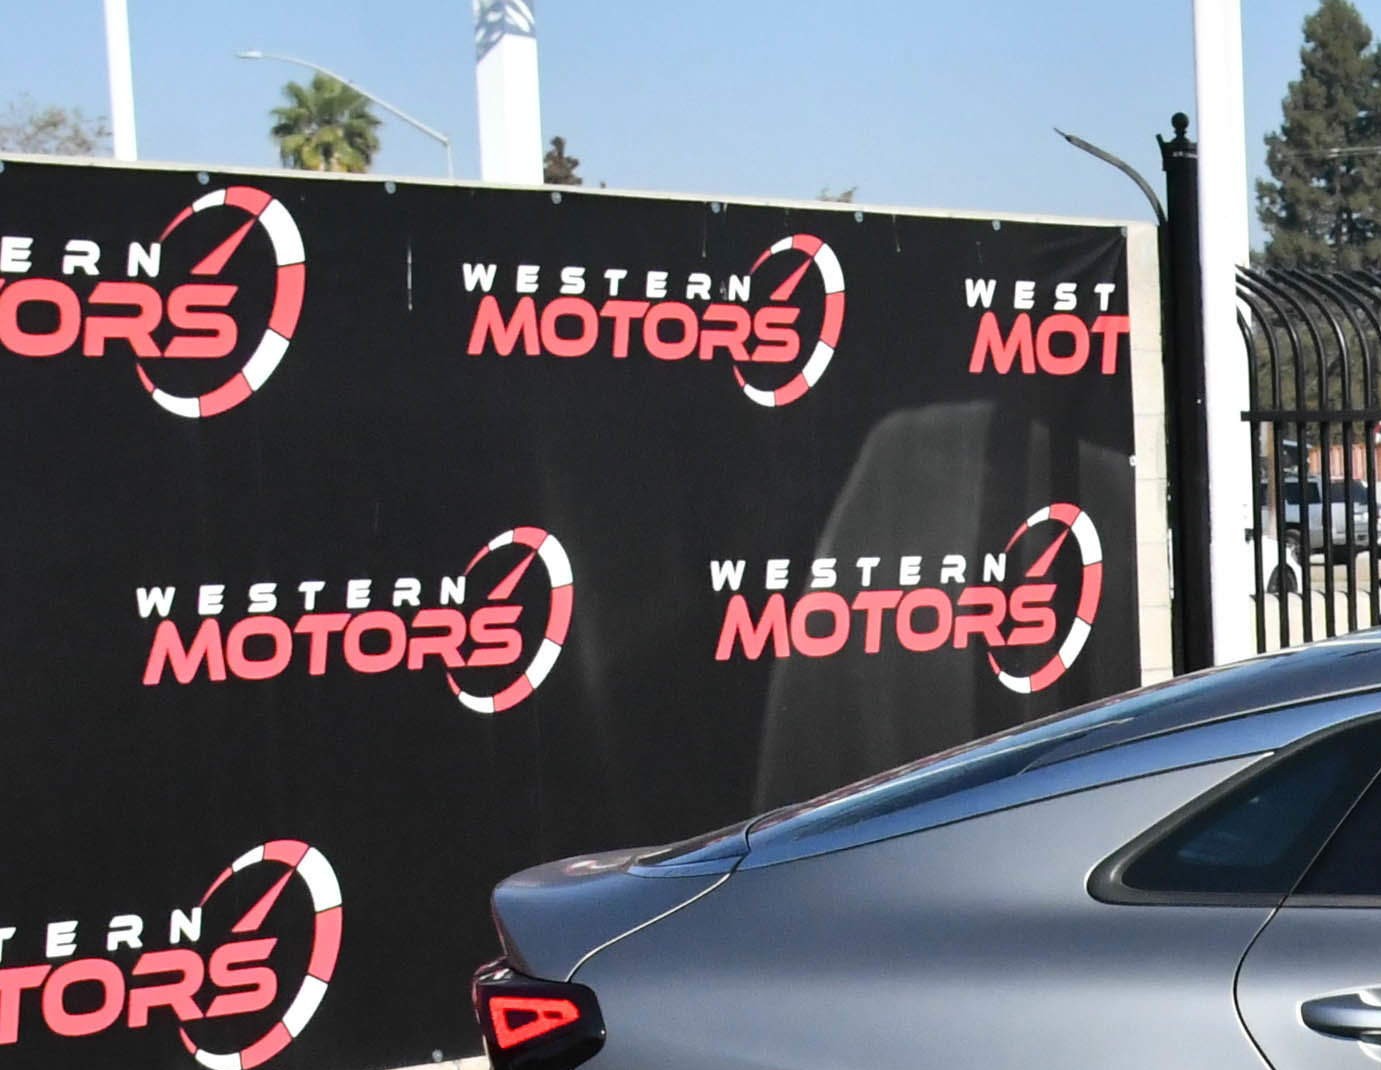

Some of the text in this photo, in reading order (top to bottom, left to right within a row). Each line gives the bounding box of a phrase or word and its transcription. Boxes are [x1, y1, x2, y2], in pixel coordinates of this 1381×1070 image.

[462, 263, 751, 302] WESTERN
[964, 278, 1116, 312] WEST
[0, 277, 239, 359] ORS
[466, 294, 801, 363] MOTORS
[968, 311, 1132, 376] MOT
[136, 575, 466, 618] WESTERN
[711, 552, 1007, 592] WESTERN
[142, 604, 524, 686] MOTORS
[714, 583, 1057, 661] MOTORS
